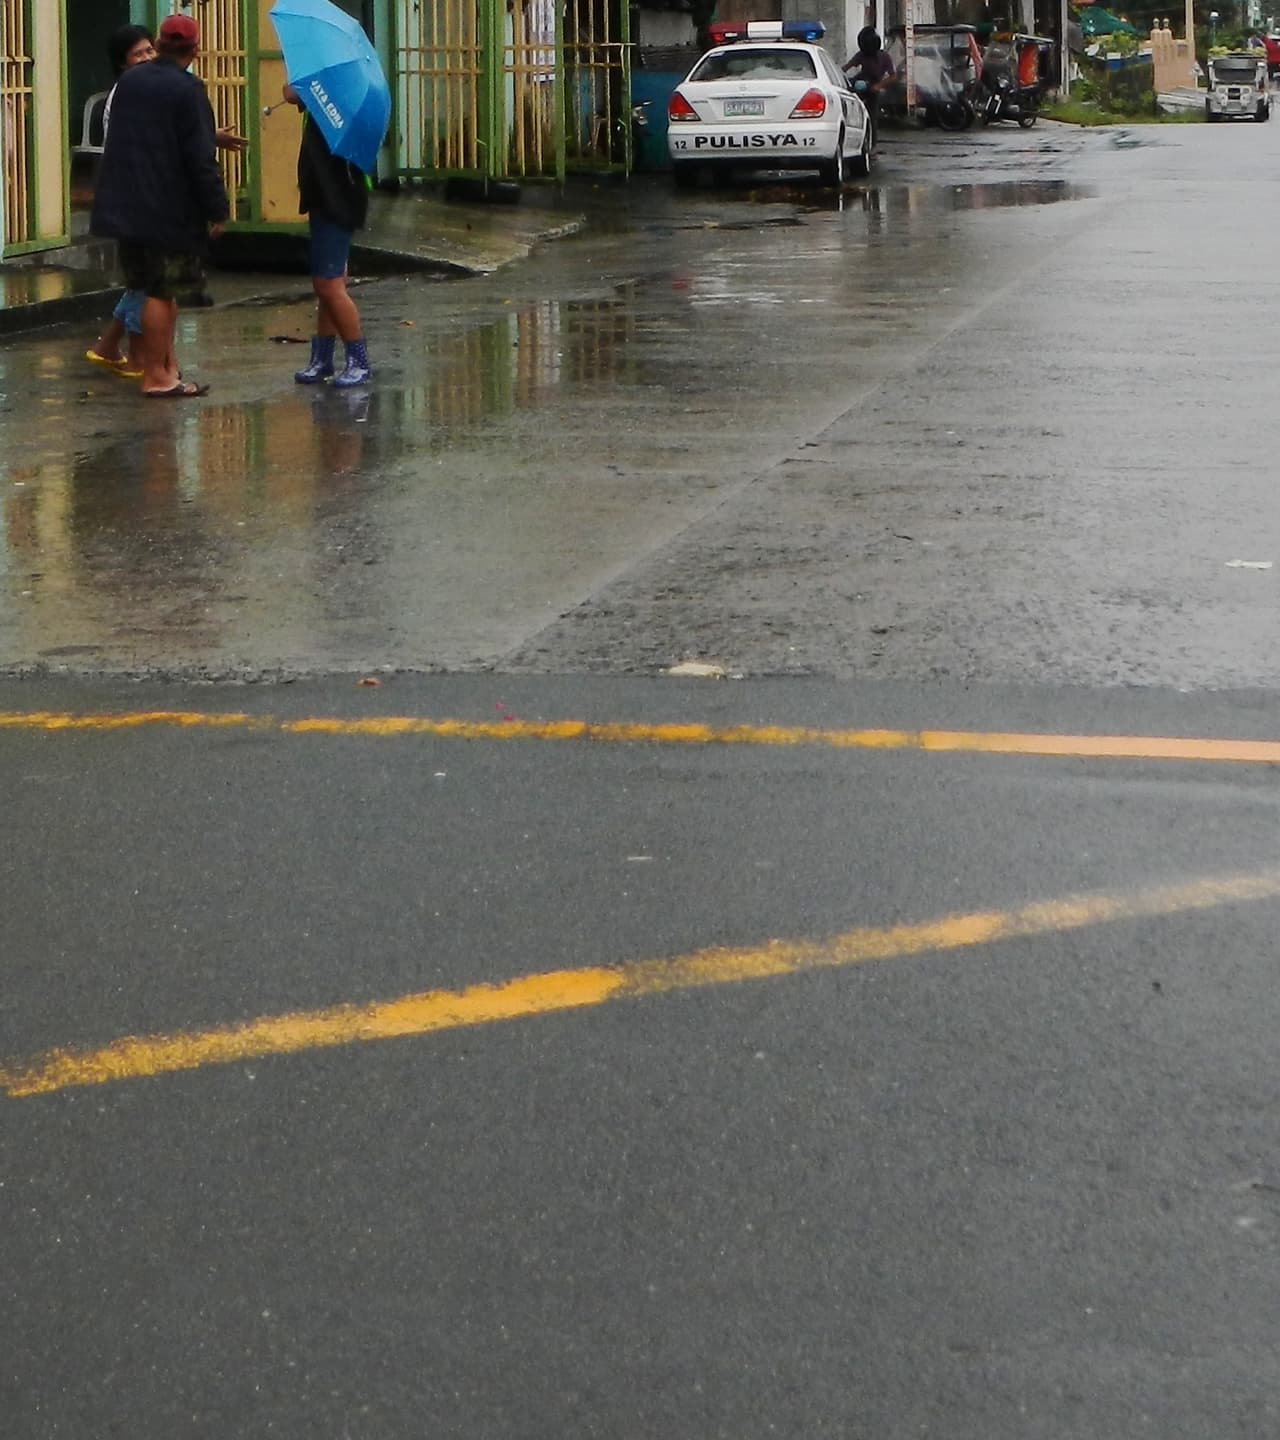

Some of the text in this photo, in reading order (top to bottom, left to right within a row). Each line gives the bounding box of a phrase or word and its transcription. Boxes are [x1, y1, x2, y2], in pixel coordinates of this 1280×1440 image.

[674, 134, 816, 149] 12 PULISYA 12
